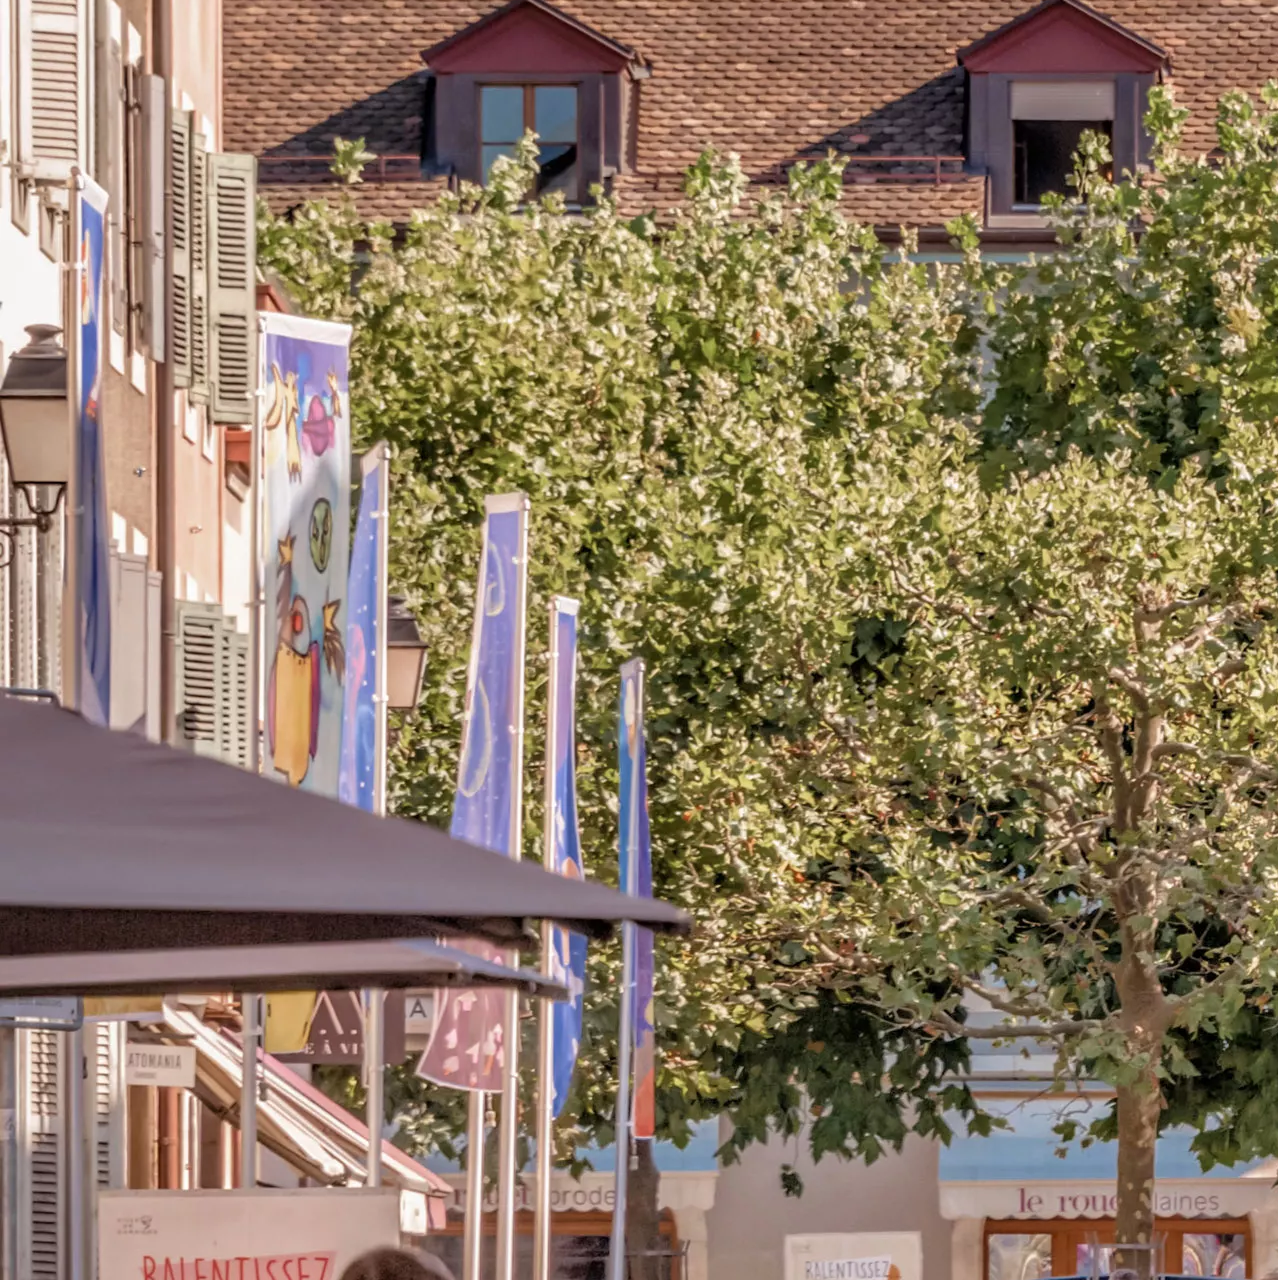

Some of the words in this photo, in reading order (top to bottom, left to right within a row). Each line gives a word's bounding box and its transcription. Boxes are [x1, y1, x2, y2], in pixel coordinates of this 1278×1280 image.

[1017, 1188, 1043, 1213] le
[1154, 1192, 1220, 1211] laines
[804, 1260, 890, 1280] RALENTISSEZ
